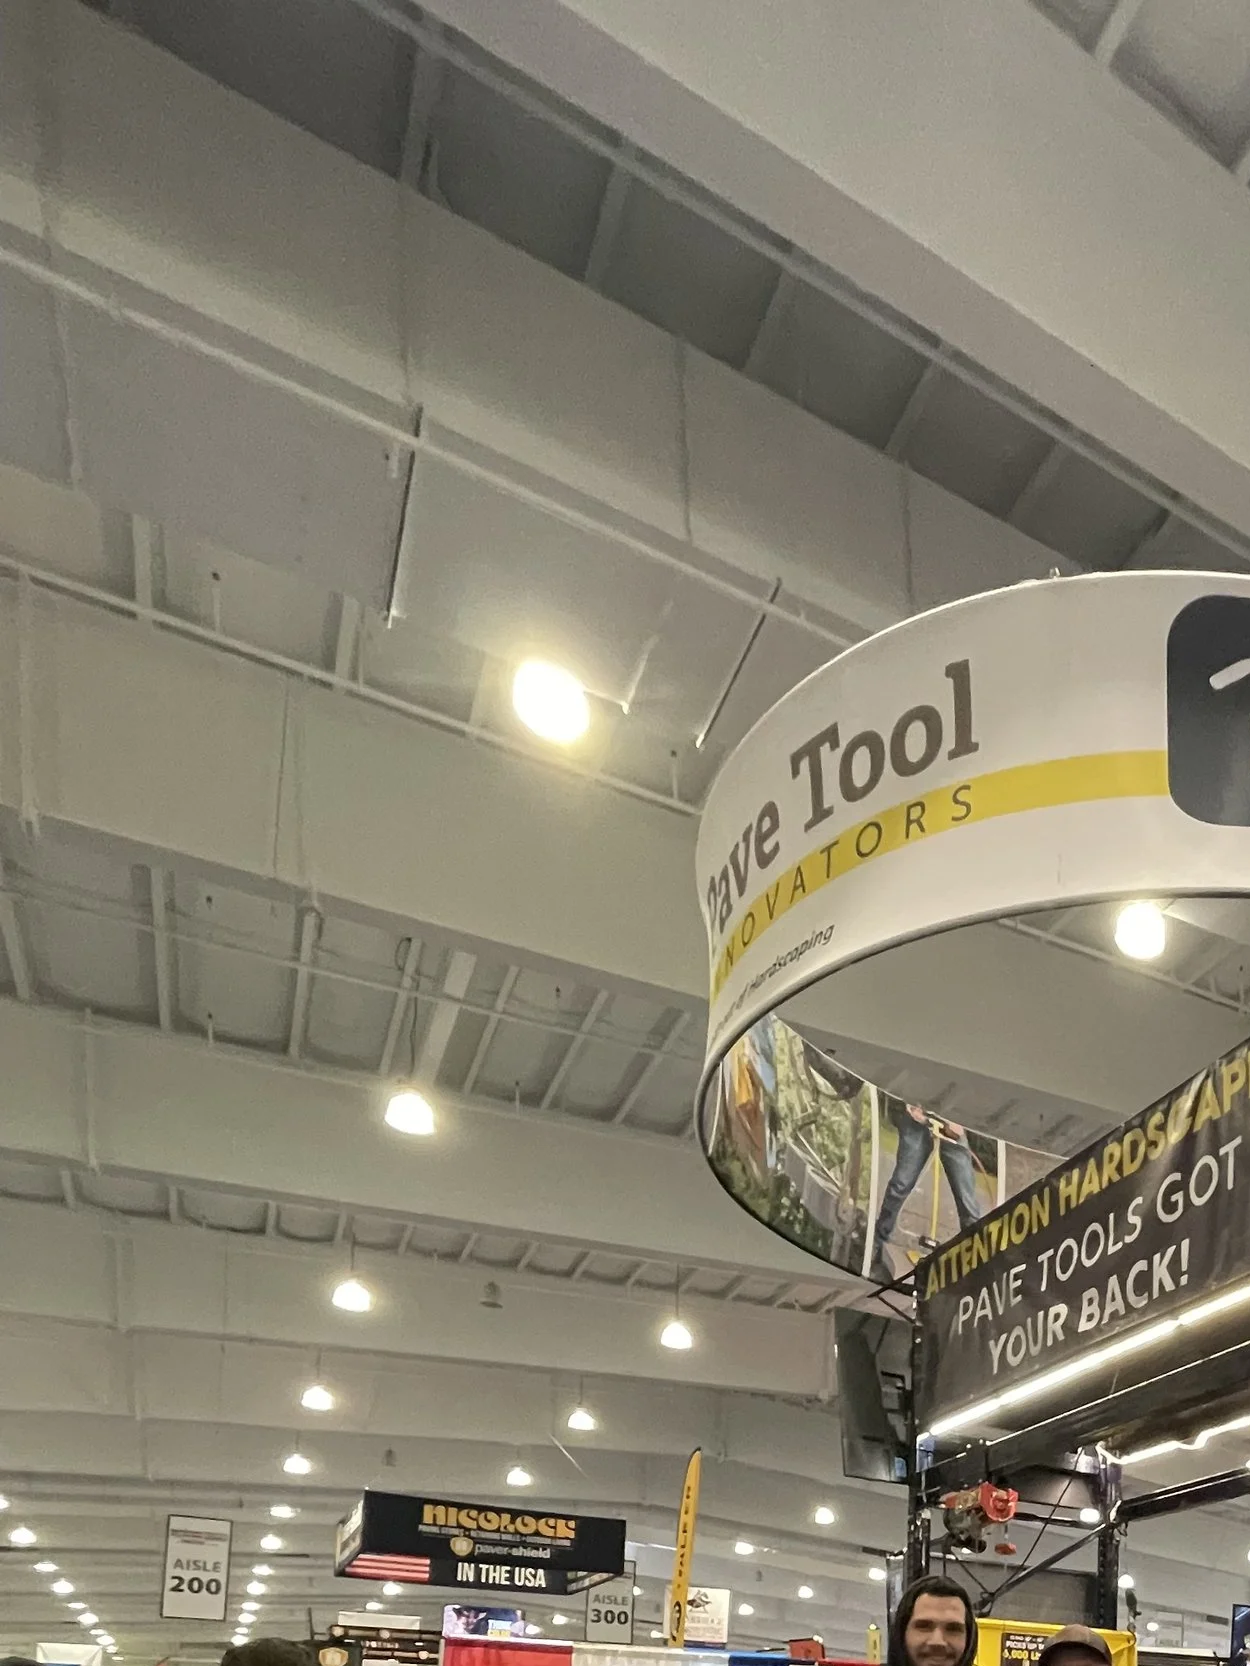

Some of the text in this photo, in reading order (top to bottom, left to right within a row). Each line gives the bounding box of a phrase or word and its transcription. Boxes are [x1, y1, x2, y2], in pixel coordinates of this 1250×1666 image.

[789, 658, 979, 833] Tool
[749, 924, 835, 994] Hardscaping
[925, 1186, 1050, 1300] ATTENTION
[958, 1135, 1243, 1335] PAVE TOOLS GOT
[988, 1238, 1191, 1376] YOUR BACK!
[422, 1504, 576, 1539] NICOLOCK
[173, 1558, 221, 1573] AISLE
[456, 1562, 547, 1588] IN THE USA
[169, 1575, 222, 1596] 200
[592, 1594, 629, 1606] AISLE
[590, 1608, 629, 1625] 300
